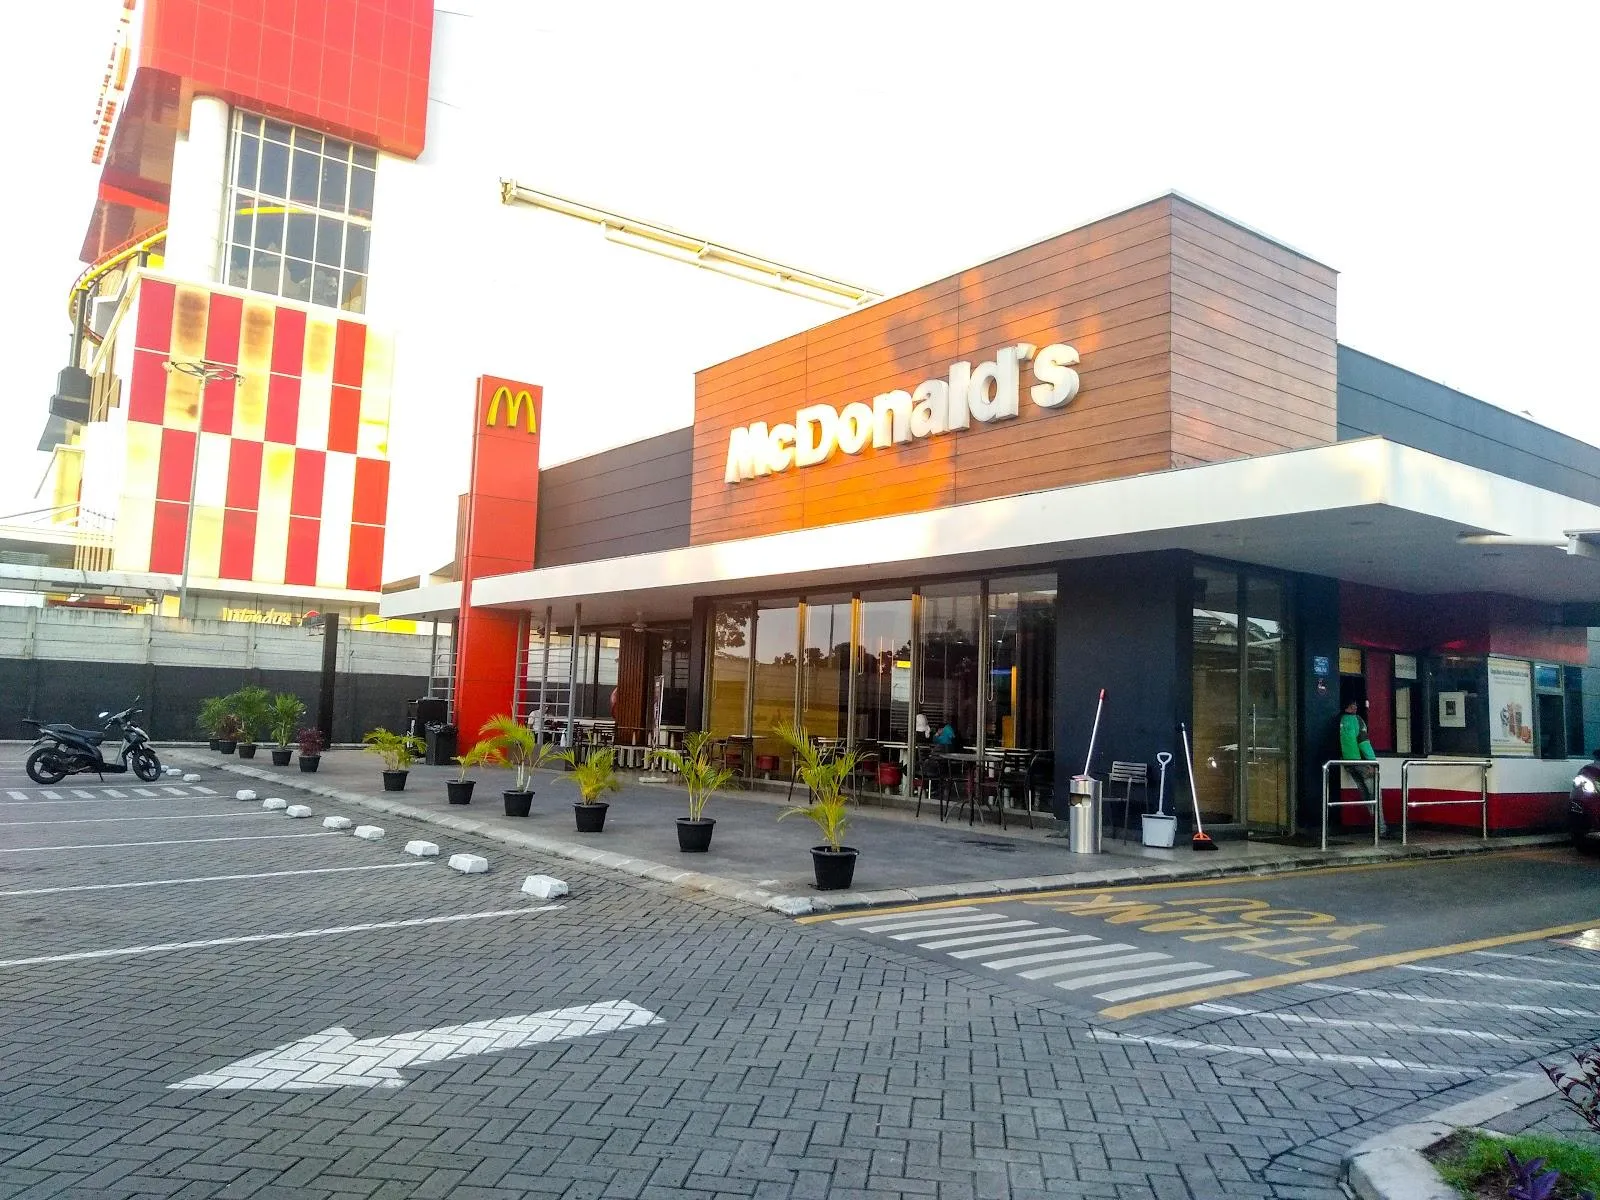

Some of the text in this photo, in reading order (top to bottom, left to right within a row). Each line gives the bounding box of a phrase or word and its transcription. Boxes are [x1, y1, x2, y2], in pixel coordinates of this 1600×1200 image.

[724, 342, 1081, 484] McDonald's
[1023, 895, 1360, 966] THANK
[1165, 898, 1386, 941] YOU
